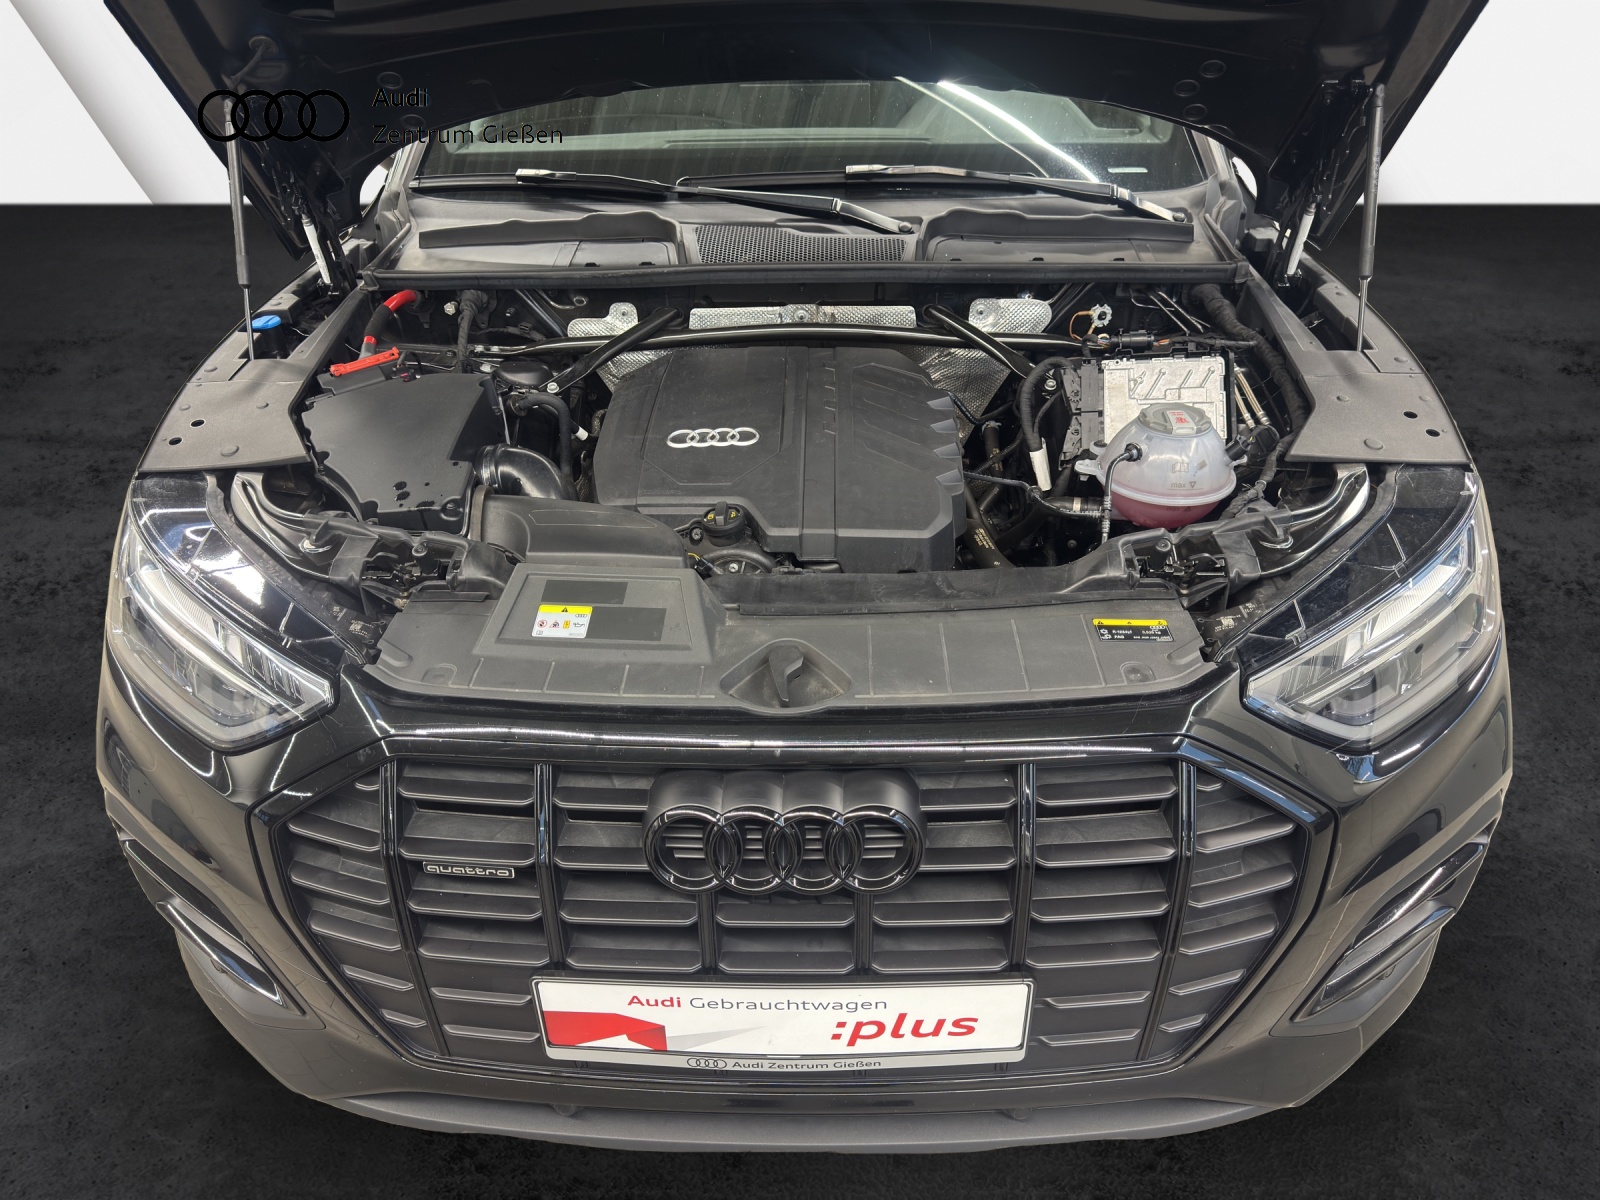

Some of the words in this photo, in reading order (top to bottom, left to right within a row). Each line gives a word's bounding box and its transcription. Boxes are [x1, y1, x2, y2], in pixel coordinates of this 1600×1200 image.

[426, 865, 510, 876] quattro
[627, 995, 682, 1008] Audi
[689, 997, 888, 1013] Gebrauchtwagen
[732, 1061, 764, 1069] Audi
[767, 1061, 829, 1070] Zentrum
[833, 1060, 882, 1069] Gießen
